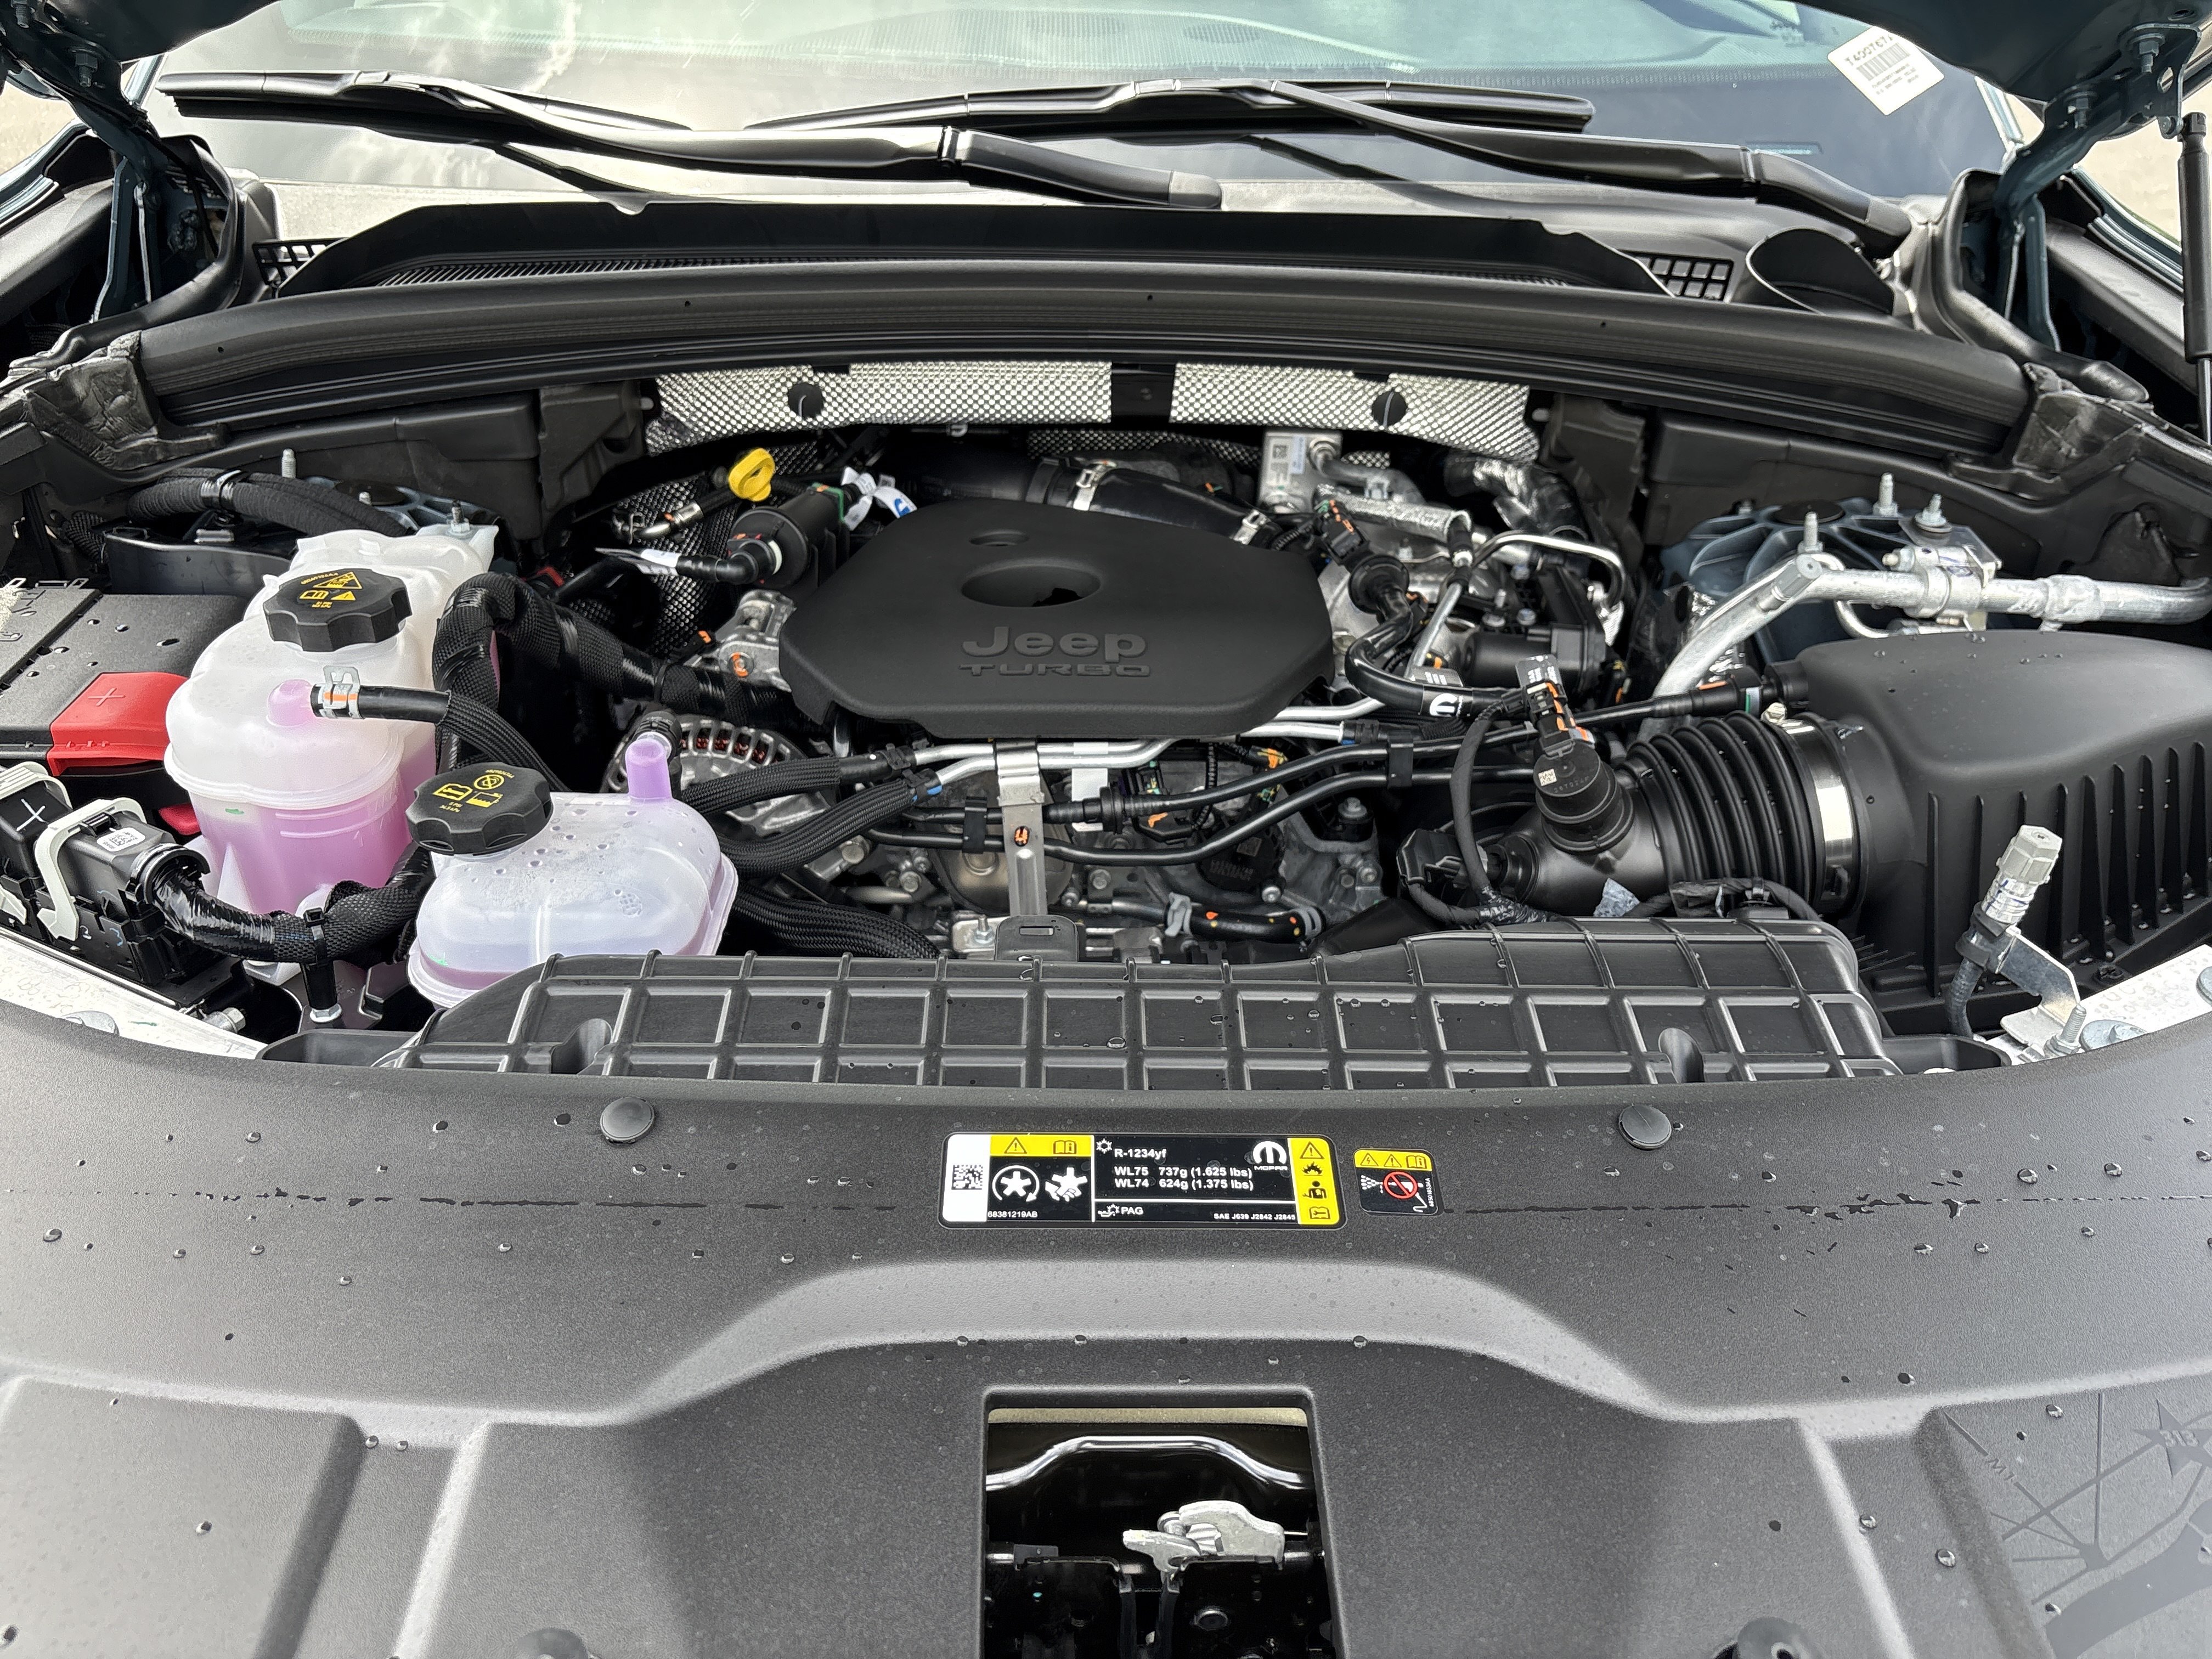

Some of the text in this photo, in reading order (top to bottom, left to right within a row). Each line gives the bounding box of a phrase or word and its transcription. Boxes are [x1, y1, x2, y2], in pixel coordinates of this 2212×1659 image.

[962, 626, 1147, 663] Jeep
[958, 663, 1151, 676] TURBO
[1114, 1148, 1167, 1160] R-1234yf
[1114, 1166, 1253, 1179] WL75 737g (1.625 lbs)
[1114, 1178, 1254, 1191] WL74 624g (1.375 lbs)
[1121, 1206, 1144, 1215] PAG
[2159, 1429, 2200, 1449] 313
